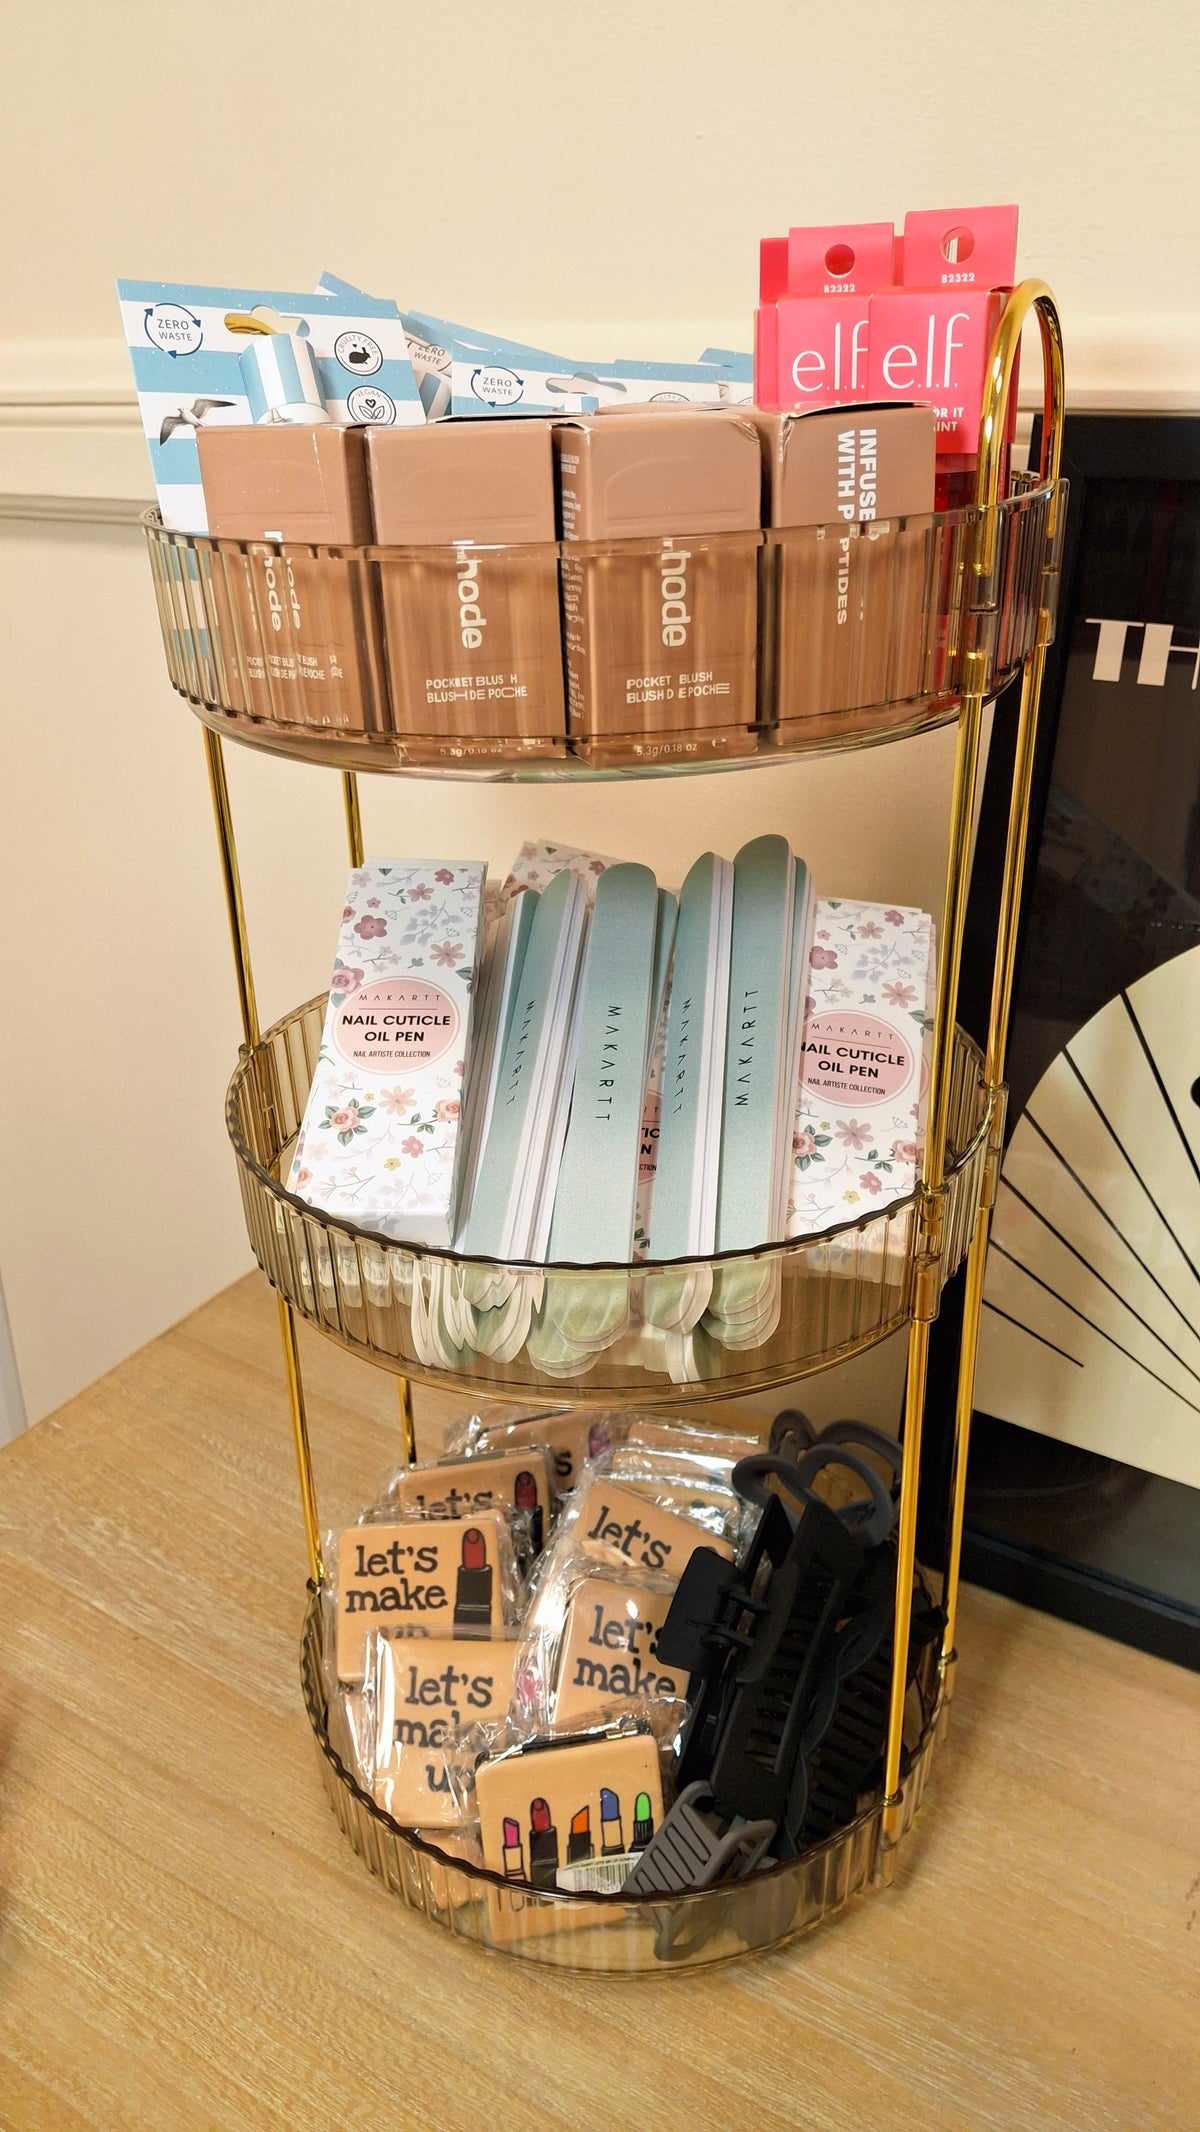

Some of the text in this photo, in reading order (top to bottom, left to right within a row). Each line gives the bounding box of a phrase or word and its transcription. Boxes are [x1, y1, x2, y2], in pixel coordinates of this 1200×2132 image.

[941, 272, 975, 284] 82322
[823, 283, 856, 294] 82322
[157, 317, 190, 331] ZERO
[158, 331, 194, 343] WASTE
[337, 334, 379, 355] CRUELTY FREE
[414, 351, 442, 366] WASTE
[482, 376, 513, 388] ZERO
[355, 388, 382, 399] VEGAN
[482, 386, 513, 397] WASTE
[934, 407, 964, 418] OR IT
[837, 430, 856, 625] WITH PPTIDES
[475, 674, 518, 686] BLUSH
[626, 671, 713, 690] POCKET BLUSH
[427, 686, 528, 704] BLUSH DE POCHE
[626, 688, 665, 704] BLUSH
[636, 743, 698, 757] 5.3g/0.18 oz
[342, 1014, 451, 1027] NAIL CUTICLE
[364, 1030, 425, 1043] OIL PEN
[353, 1049, 431, 1059] NAIL ARTISTE COLLECTION
[836, 1047, 905, 1067] CUTICLE
[818, 1059, 879, 1079] OIL PEN
[807, 1077, 886, 1096] NAIL ARTISTE COLLECTION
[587, 1505, 672, 1570] let's
[354, 1541, 439, 1577] let's
[345, 1578, 449, 1613] make
[573, 1658, 676, 1696] make
[404, 1664, 494, 1708] let's
